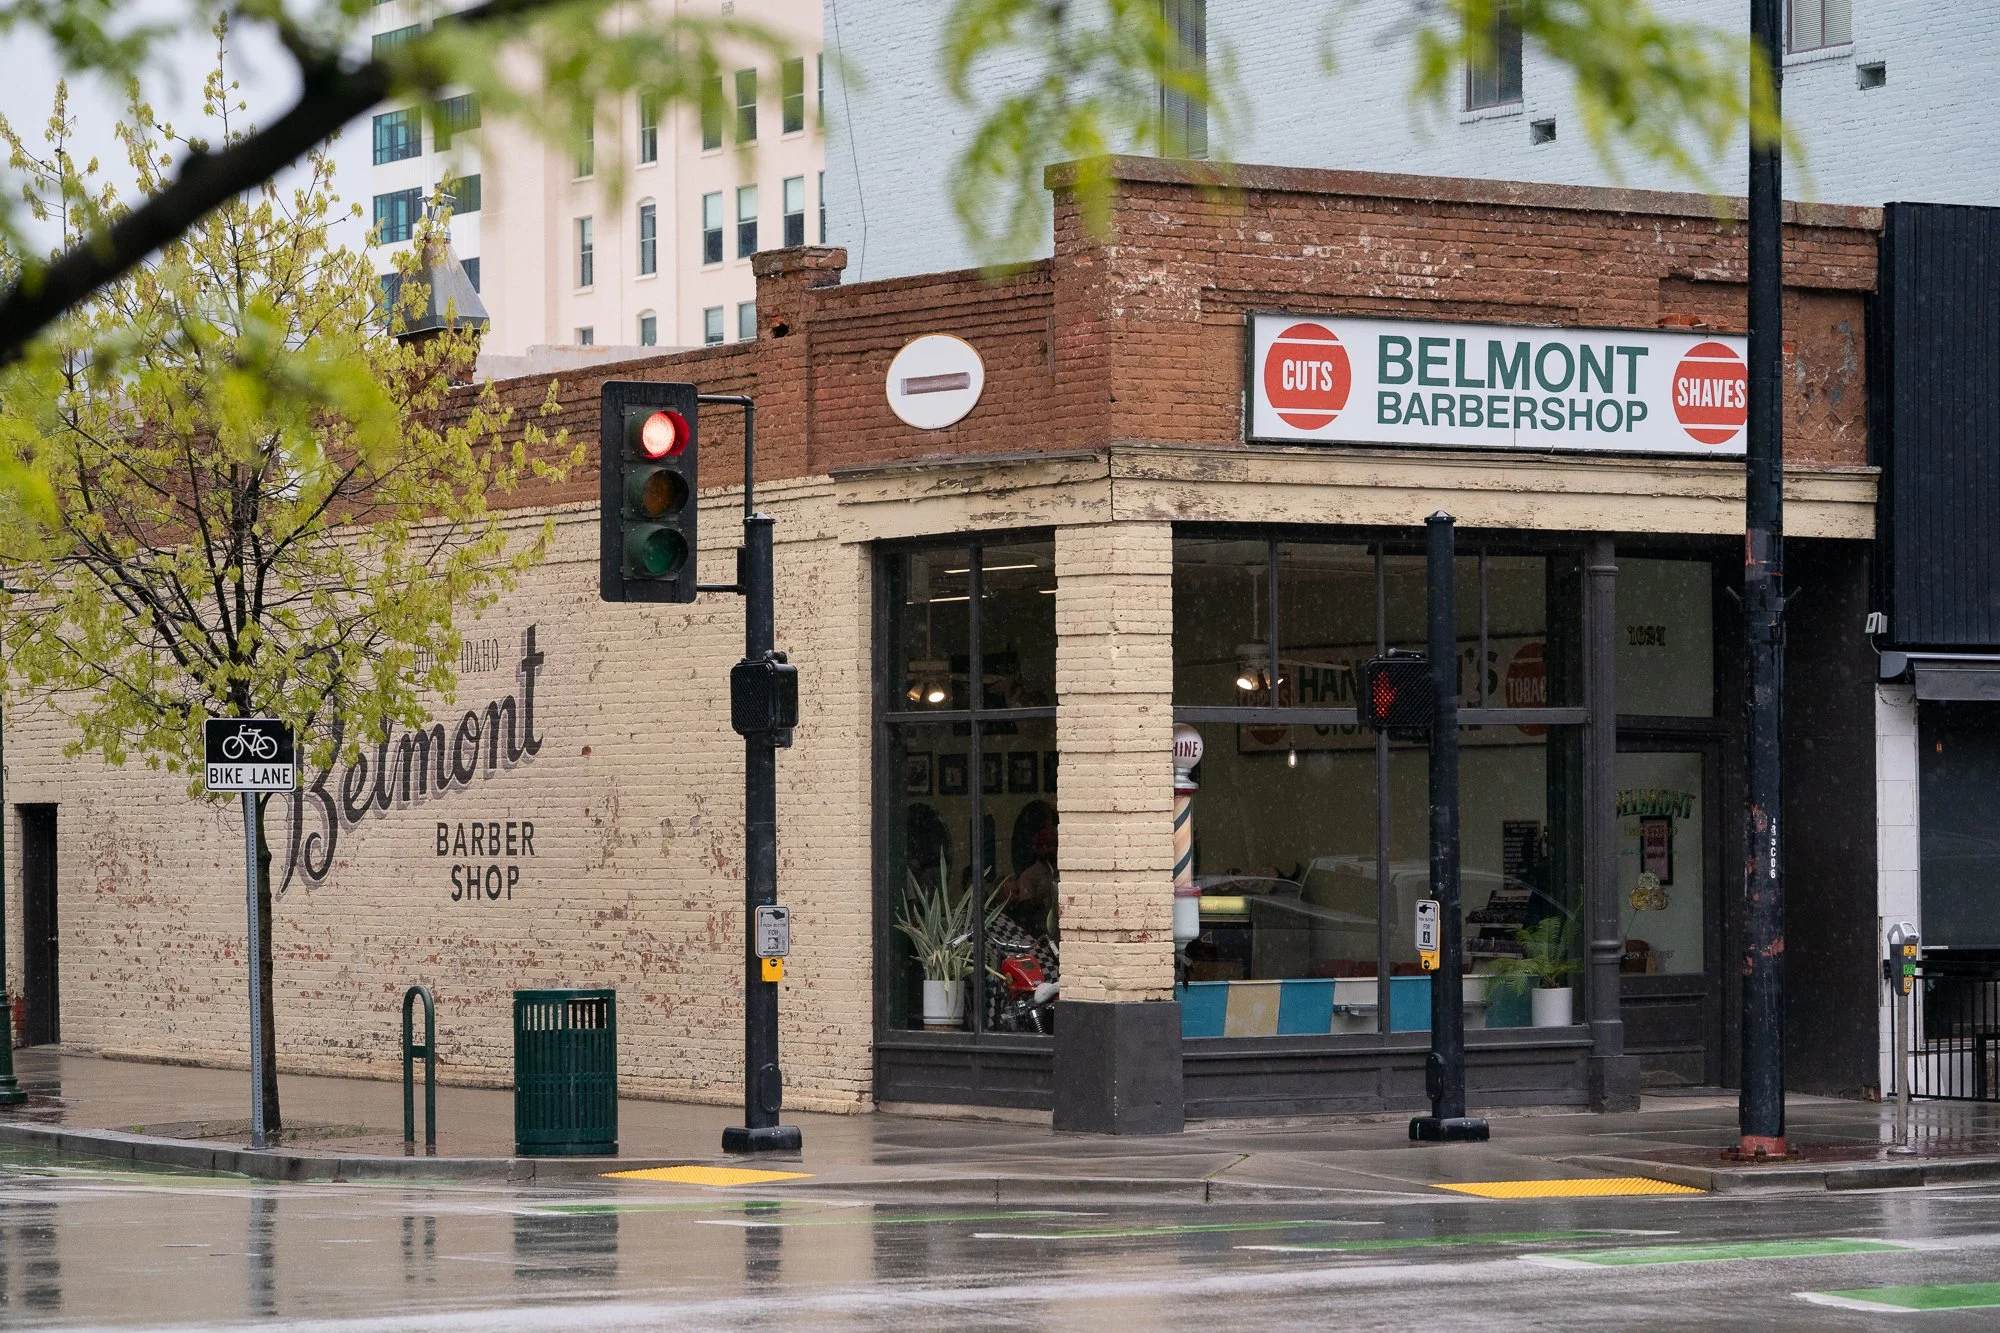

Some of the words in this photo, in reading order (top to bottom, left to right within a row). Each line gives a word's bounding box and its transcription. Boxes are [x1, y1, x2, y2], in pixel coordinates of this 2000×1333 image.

[1282, 359, 1333, 392] CUTS
[1377, 335, 1649, 395] BELMONT
[1677, 377, 1746, 409] SHAVES
[1377, 391, 1648, 433] BARBERSHOP
[461, 638, 499, 673] IDAHO
[1172, 740, 1198, 758] HINE
[210, 767, 244, 785] BIKE
[252, 767, 291, 785] LANE
[436, 822, 536, 857] BARBER
[450, 864, 520, 901] SHOP
